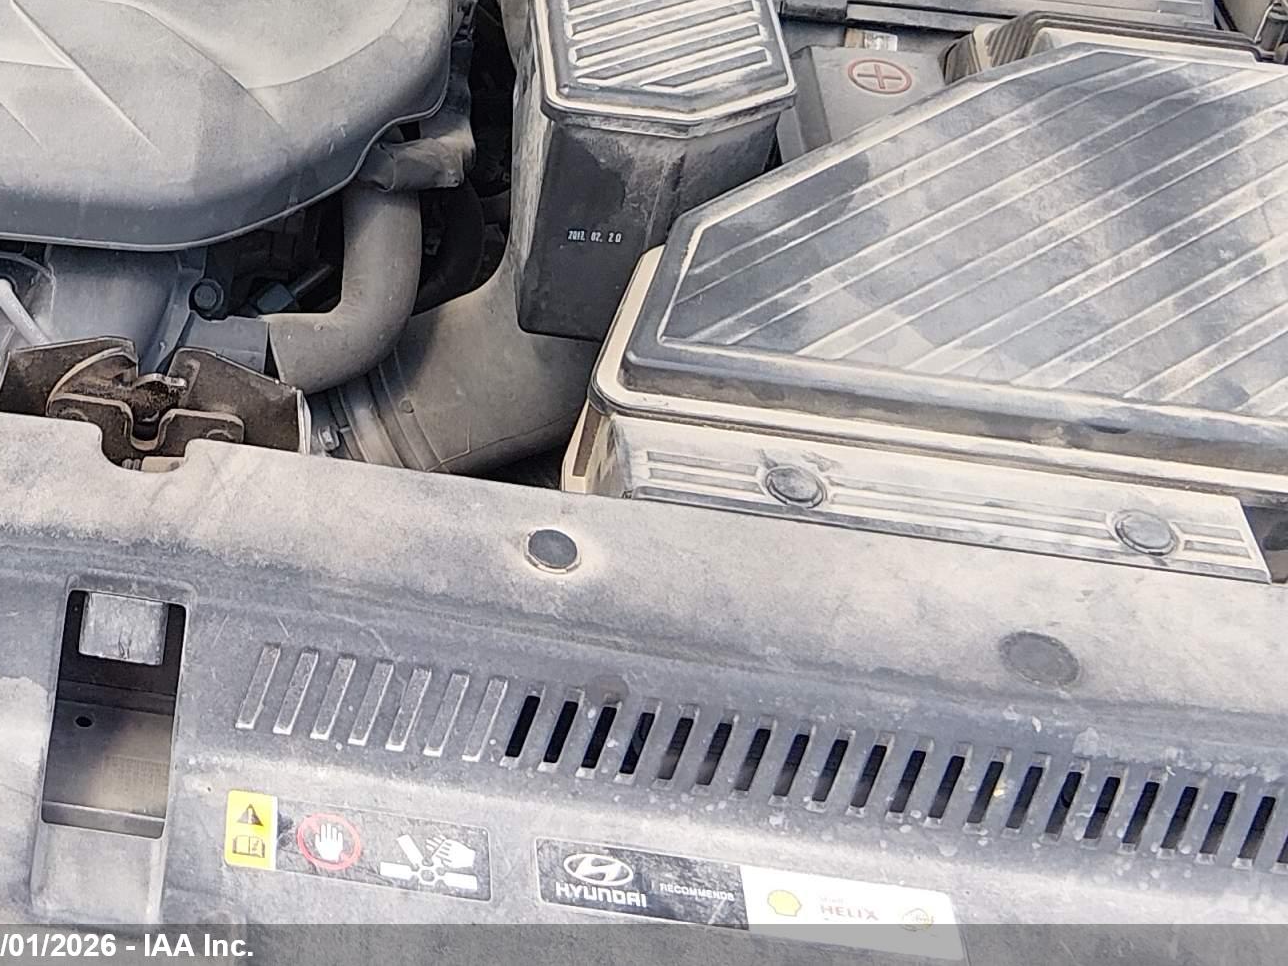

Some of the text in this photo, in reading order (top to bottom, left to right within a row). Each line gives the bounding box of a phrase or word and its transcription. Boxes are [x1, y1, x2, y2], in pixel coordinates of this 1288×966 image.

[555, 882, 736, 908] HYUNDAI RECOMMENDS
[819, 904, 880, 921] HELIX
